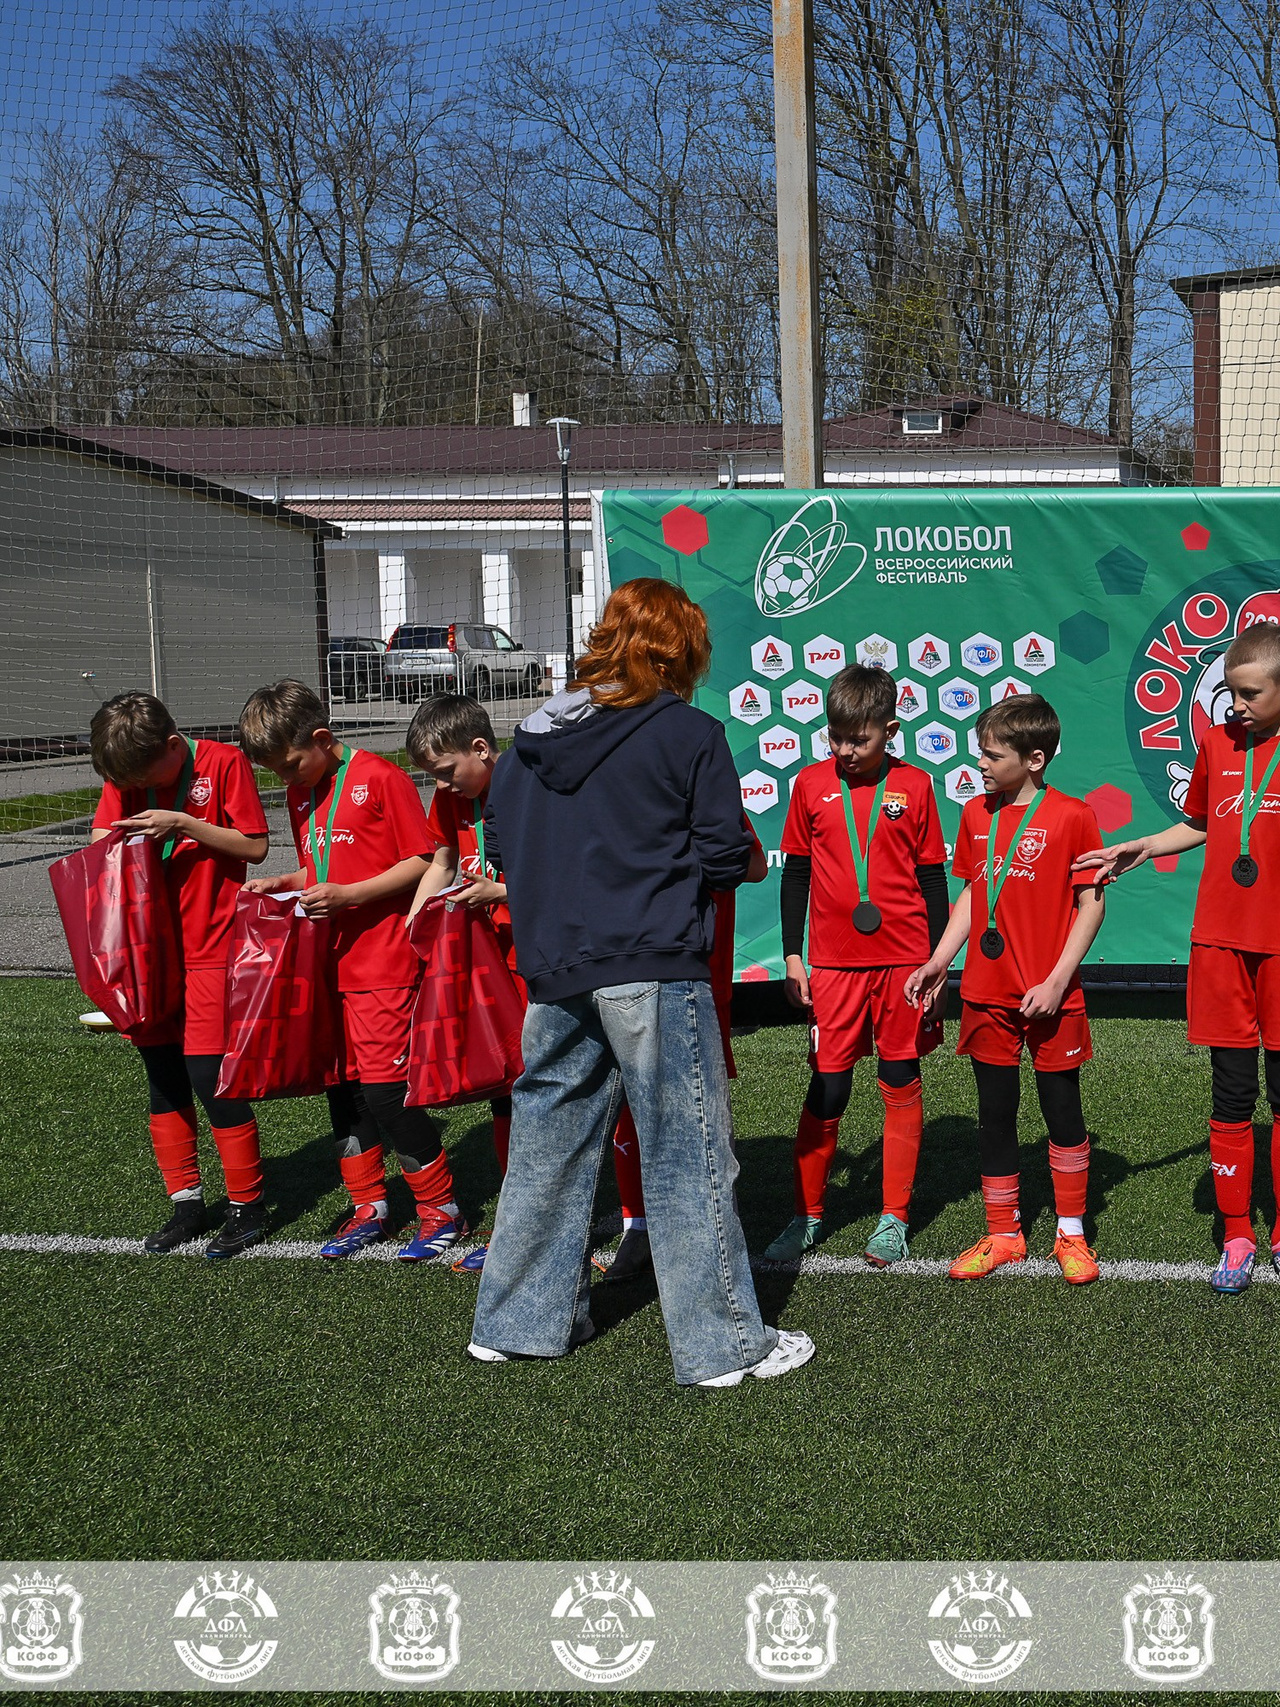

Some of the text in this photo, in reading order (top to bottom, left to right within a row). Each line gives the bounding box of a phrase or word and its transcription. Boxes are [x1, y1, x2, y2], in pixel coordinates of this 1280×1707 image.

[873, 525, 1013, 552] ЛОКОБОЛ
[874, 554, 1014, 571] ВСЕРОССИЙСКИЙ
[875, 570, 968, 584] ФЕСТИВАЛЬ
[301, 826, 355, 855] Юнсть
